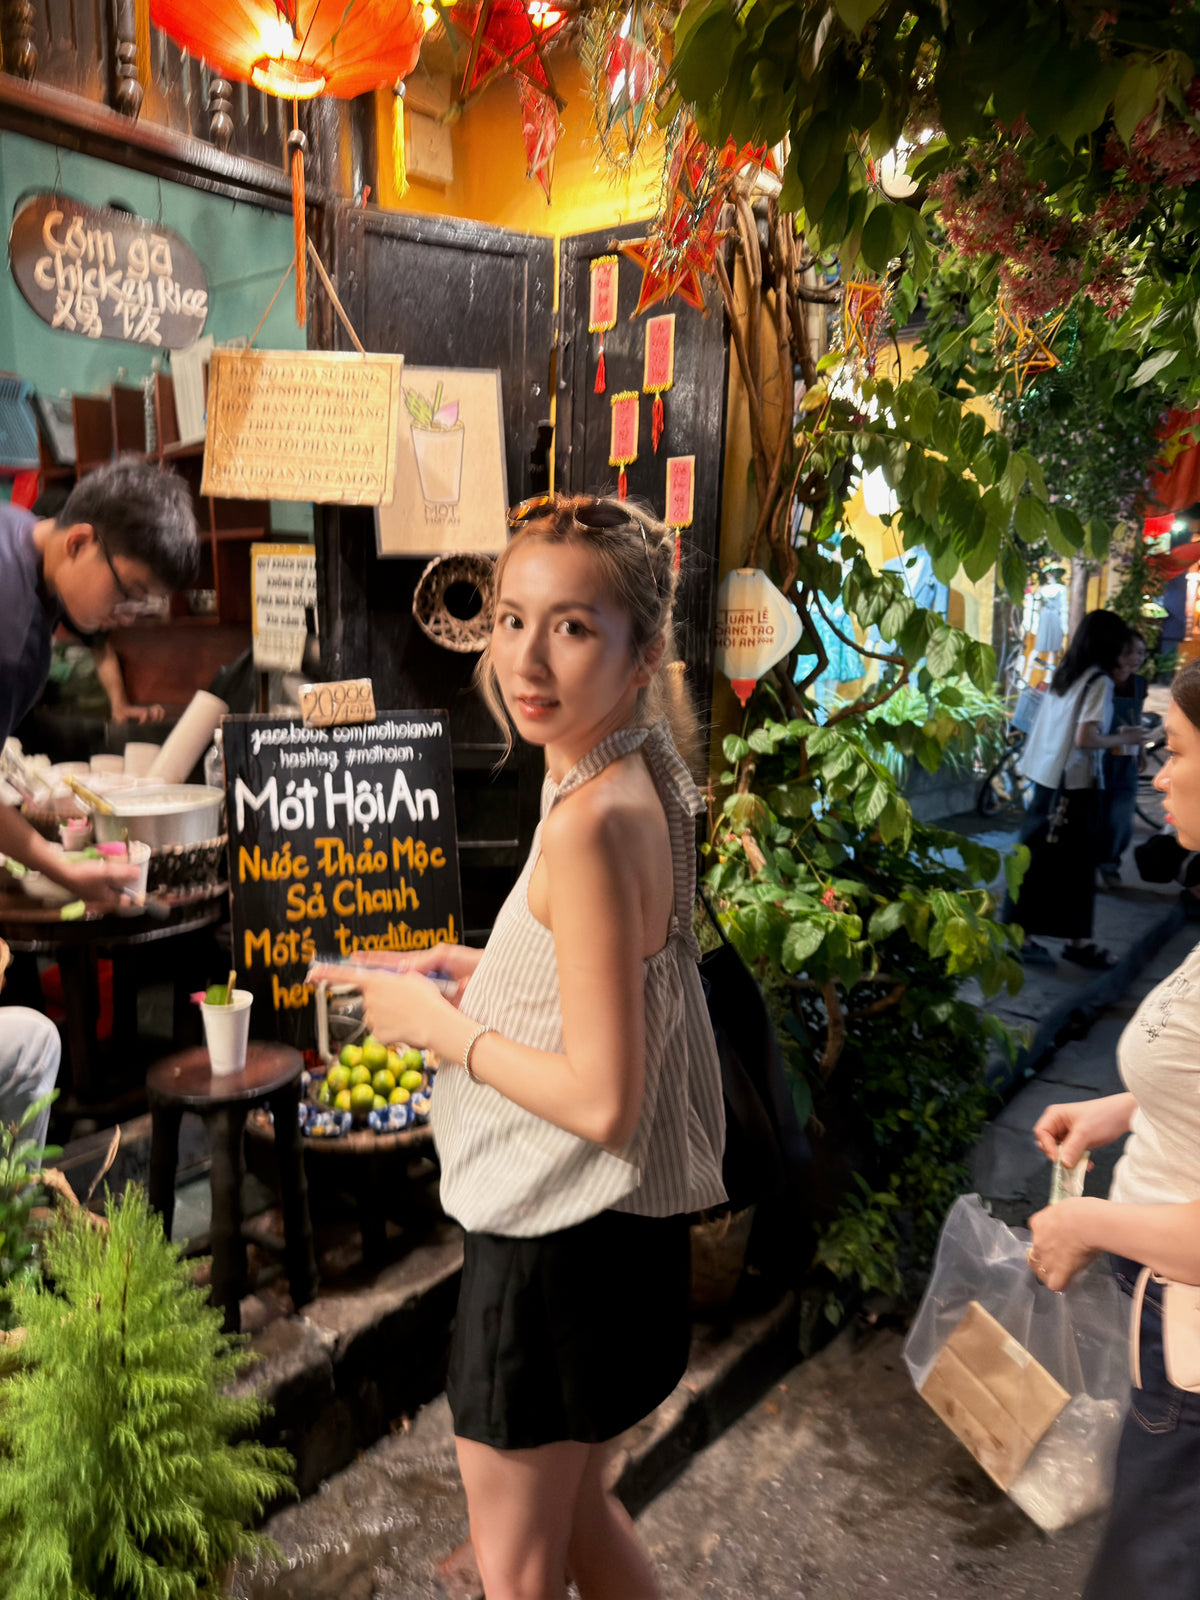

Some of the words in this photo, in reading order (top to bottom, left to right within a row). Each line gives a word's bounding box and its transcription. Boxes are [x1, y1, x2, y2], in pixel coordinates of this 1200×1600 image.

[158, 276, 208, 318] Rice
[739, 637, 756, 648] AN
[279, 746, 340, 773] hashtag
[234, 775, 319, 833] Mót
[323, 769, 387, 834] Hội
[387, 768, 440, 824] An
[239, 840, 310, 884] Nước
[314, 836, 388, 878] Thảo
[392, 835, 447, 877] Mộc
[286, 881, 328, 922] Sả
[333, 876, 420, 917] Chanh
[334, 913, 459, 957] traditional
